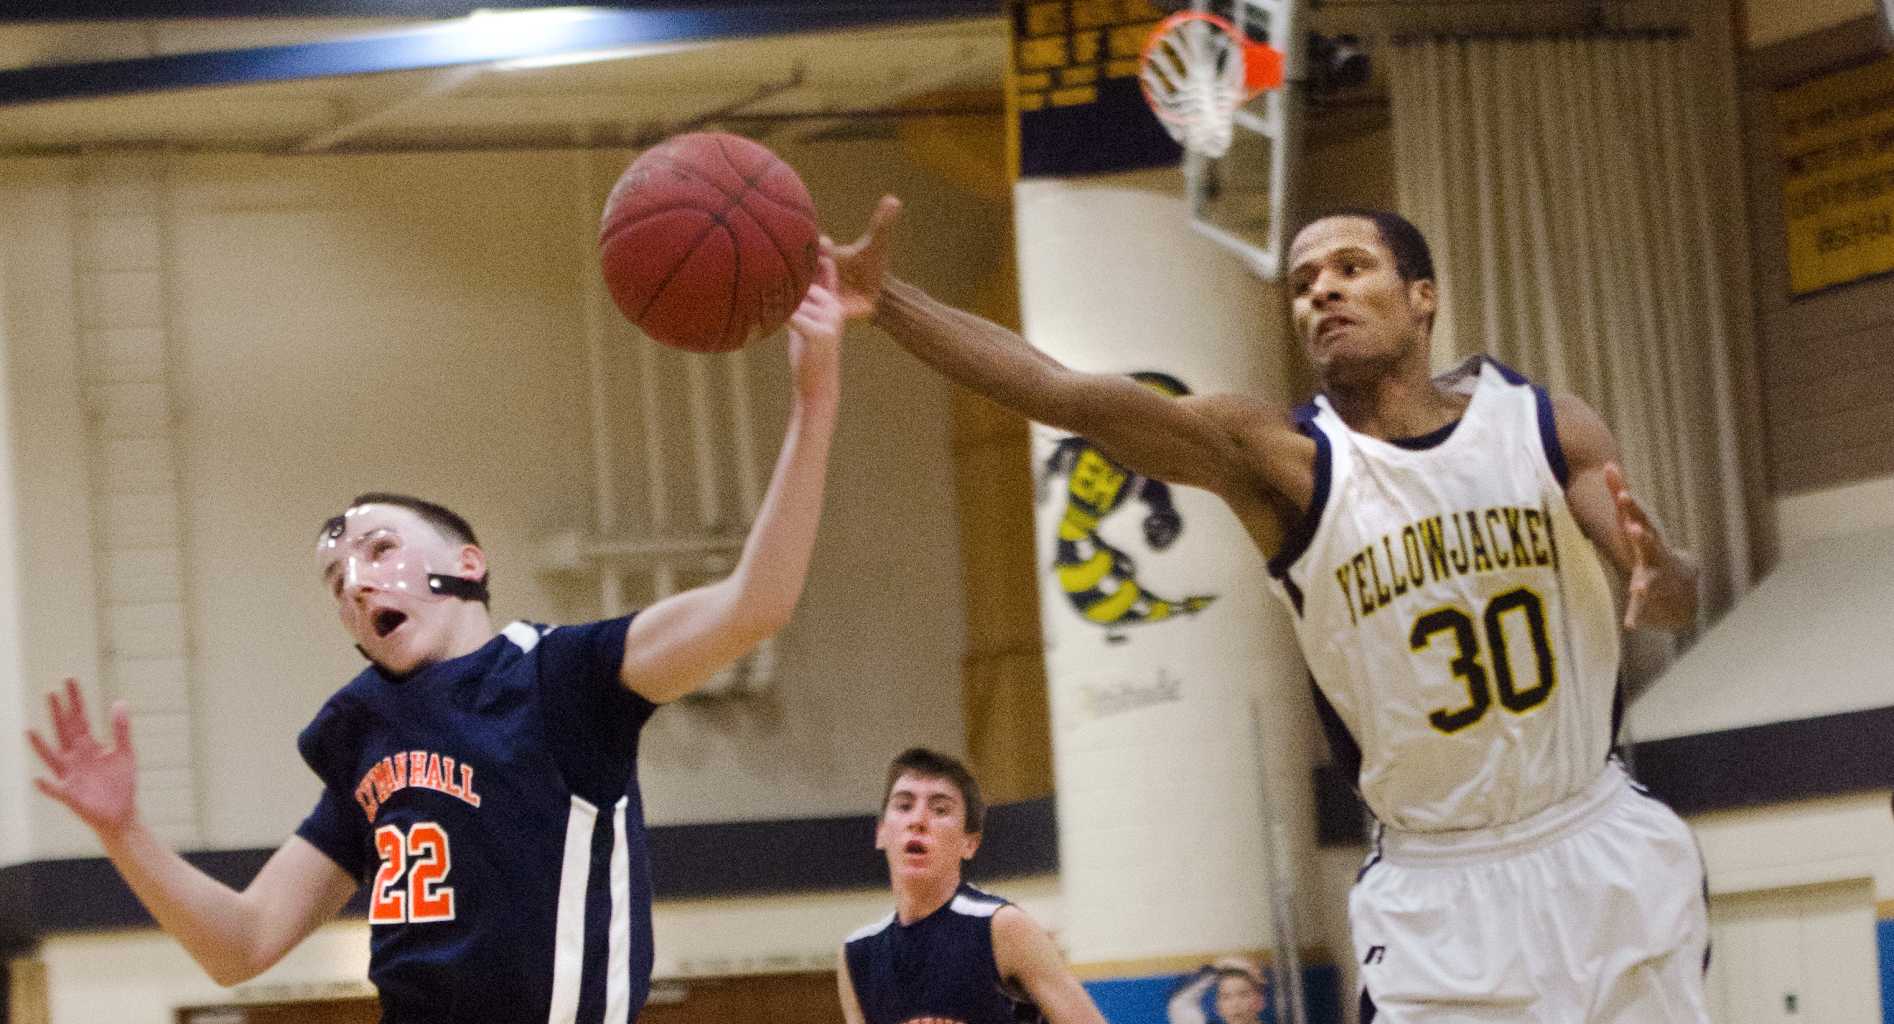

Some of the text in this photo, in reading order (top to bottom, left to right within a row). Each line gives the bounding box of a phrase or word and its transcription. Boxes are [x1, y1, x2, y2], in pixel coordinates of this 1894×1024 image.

[1335, 504, 1559, 627] YELLOWJACKE
[1409, 585, 1557, 735] 30
[368, 822, 456, 925] 22
